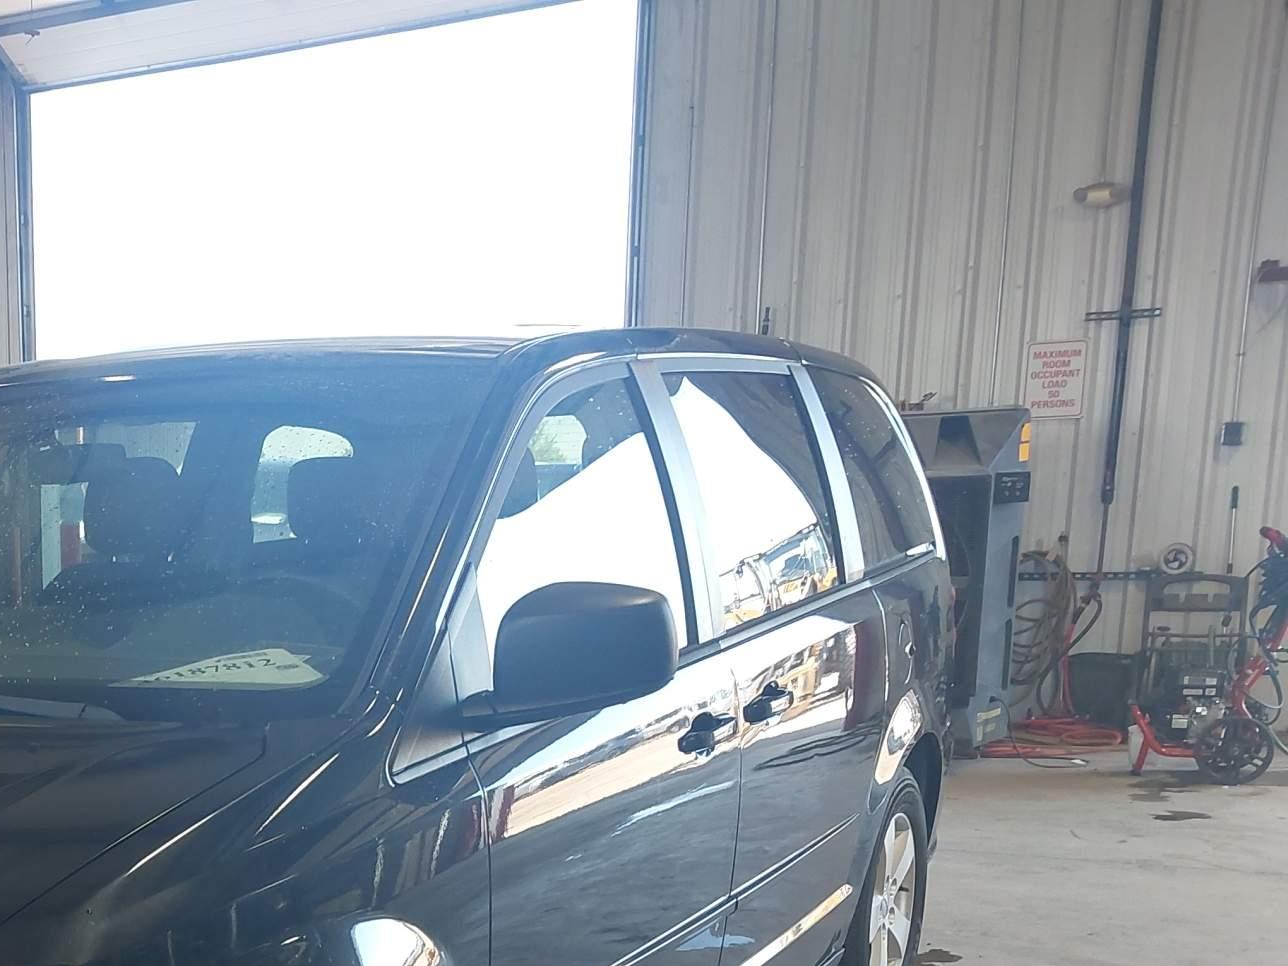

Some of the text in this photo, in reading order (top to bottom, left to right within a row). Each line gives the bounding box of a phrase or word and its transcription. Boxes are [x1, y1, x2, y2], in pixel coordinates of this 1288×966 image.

[1033, 350, 1082, 360] MAXIMUM
[1042, 360, 1071, 369] ROOM
[1031, 369, 1081, 379] OCCUPANT
[1042, 380, 1067, 389] LOAD
[1048, 390, 1060, 398] 50
[1031, 399, 1075, 409] PERSONS
[142, 658, 277, 684] 187812
